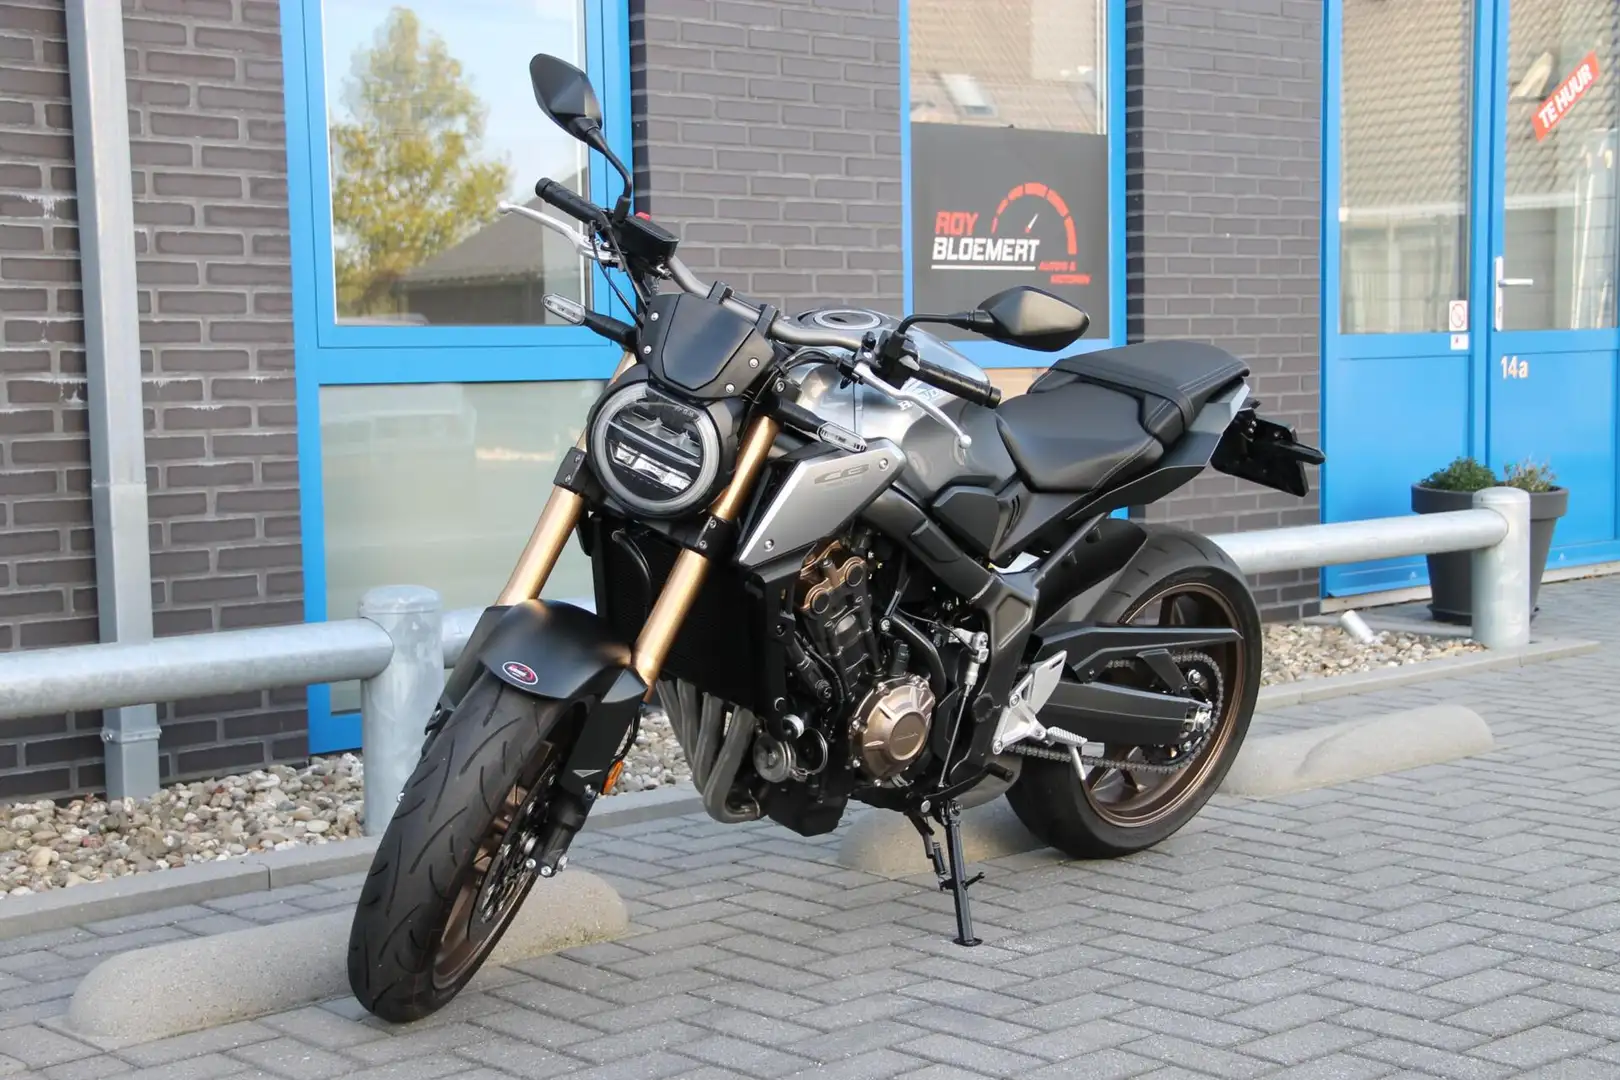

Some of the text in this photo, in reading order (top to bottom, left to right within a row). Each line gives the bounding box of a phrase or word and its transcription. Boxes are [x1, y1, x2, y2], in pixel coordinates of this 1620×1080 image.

[1538, 63, 1592, 129] TE HUUR
[935, 210, 979, 236] ROY
[932, 237, 1040, 262] BLOEMERT
[1501, 355, 1529, 379] 14a
